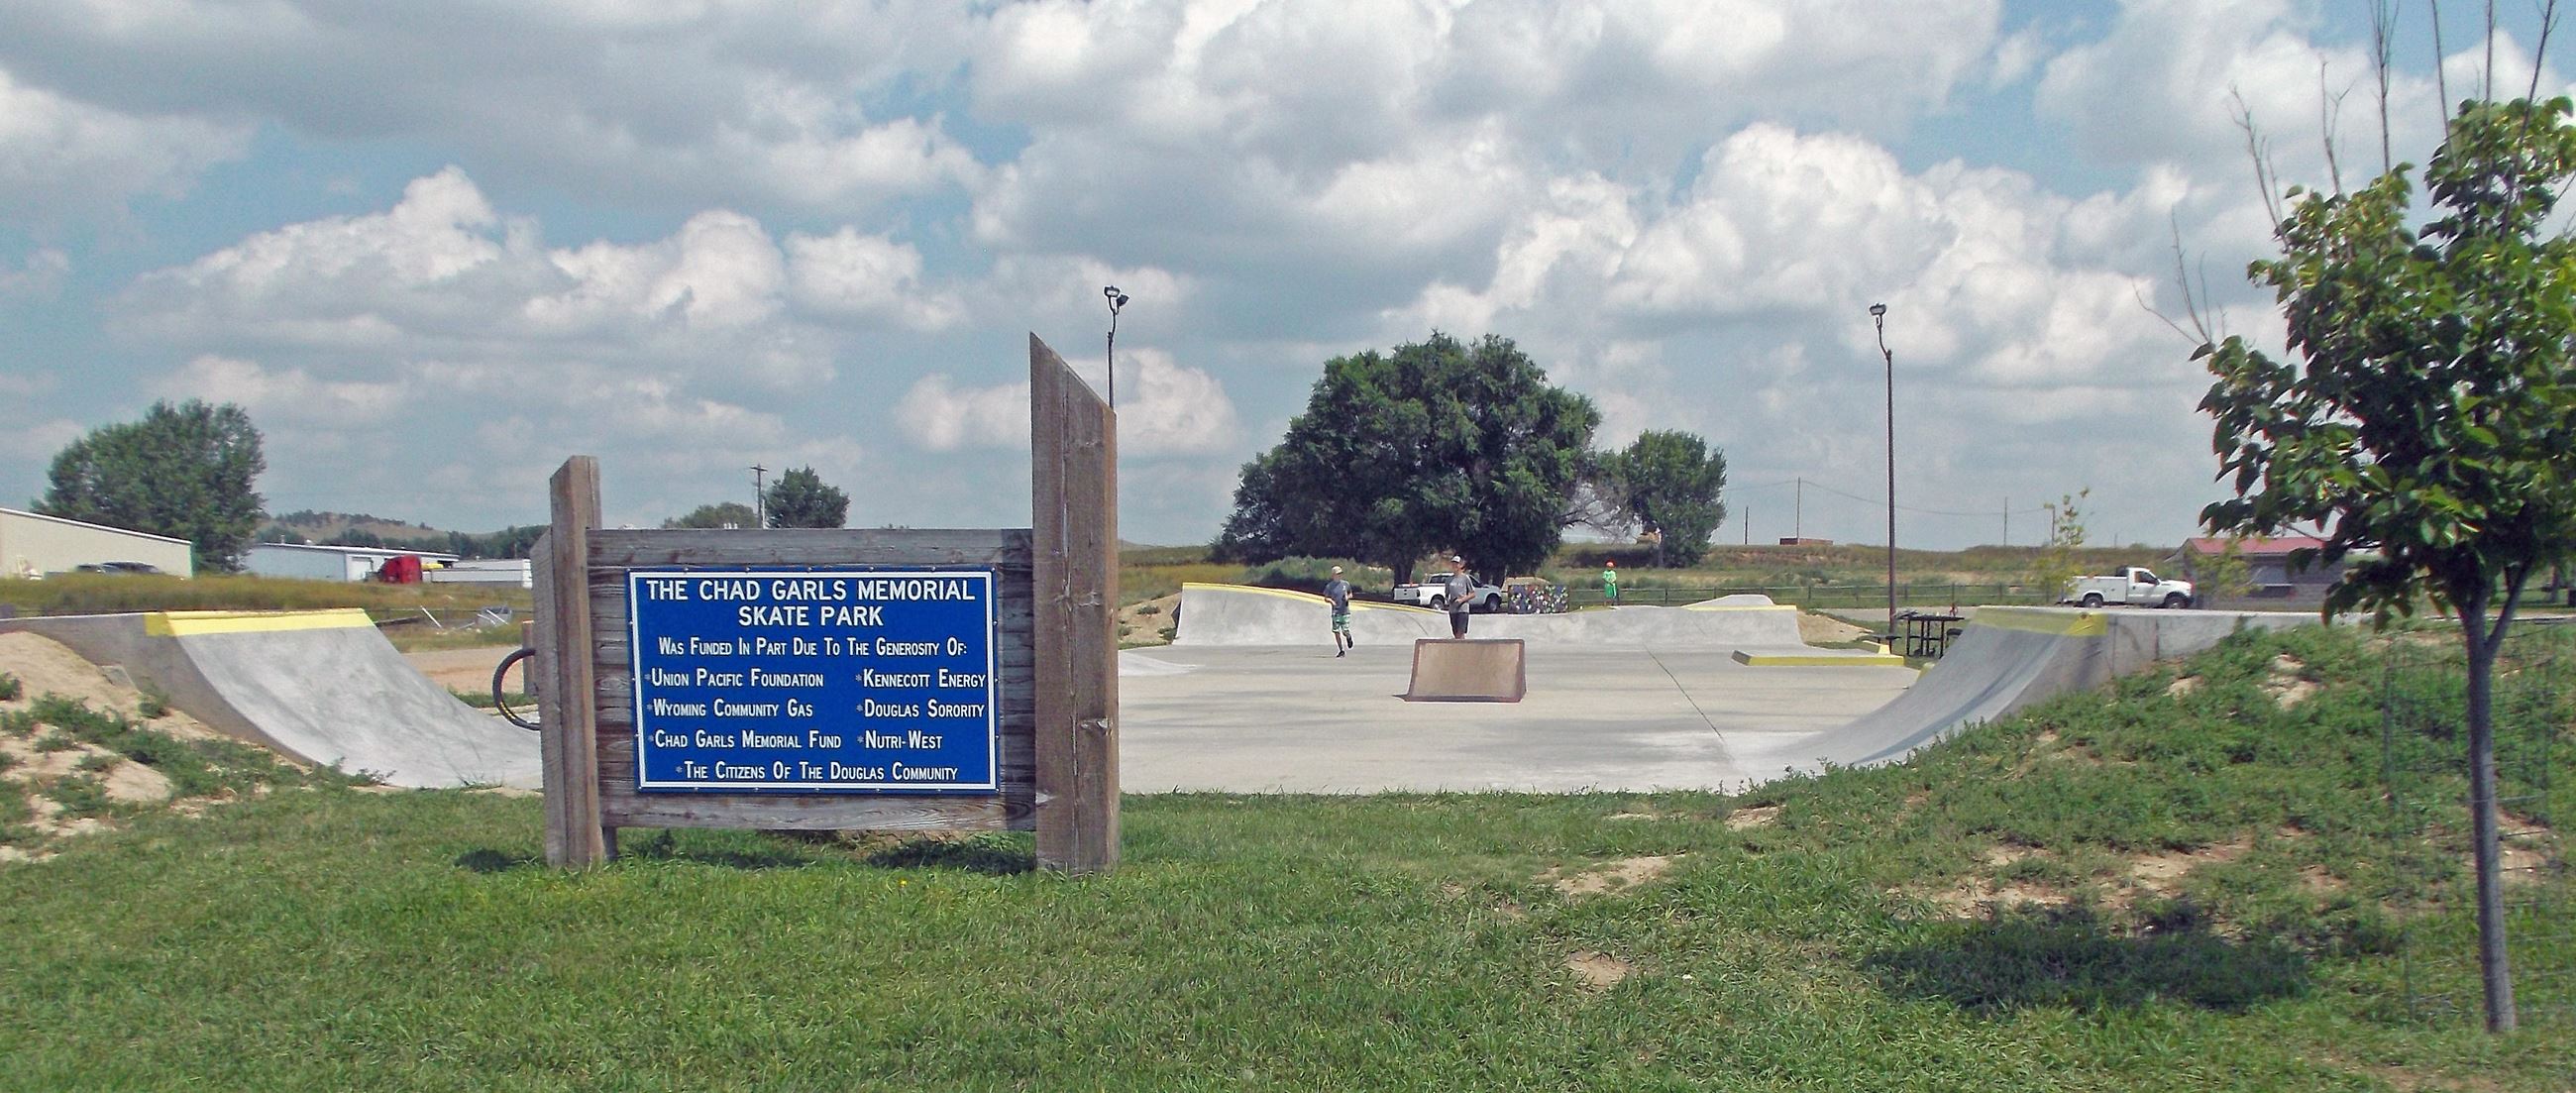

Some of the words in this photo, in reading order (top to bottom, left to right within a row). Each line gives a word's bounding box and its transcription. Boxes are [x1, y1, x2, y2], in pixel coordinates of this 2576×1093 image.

[647, 581, 688, 600] THE
[699, 581, 760, 600] CHAD
[772, 581, 847, 601] GARLS
[858, 581, 975, 601] MEMORIAL
[739, 606, 808, 625] SKATE
[821, 606, 883, 626] PARK
